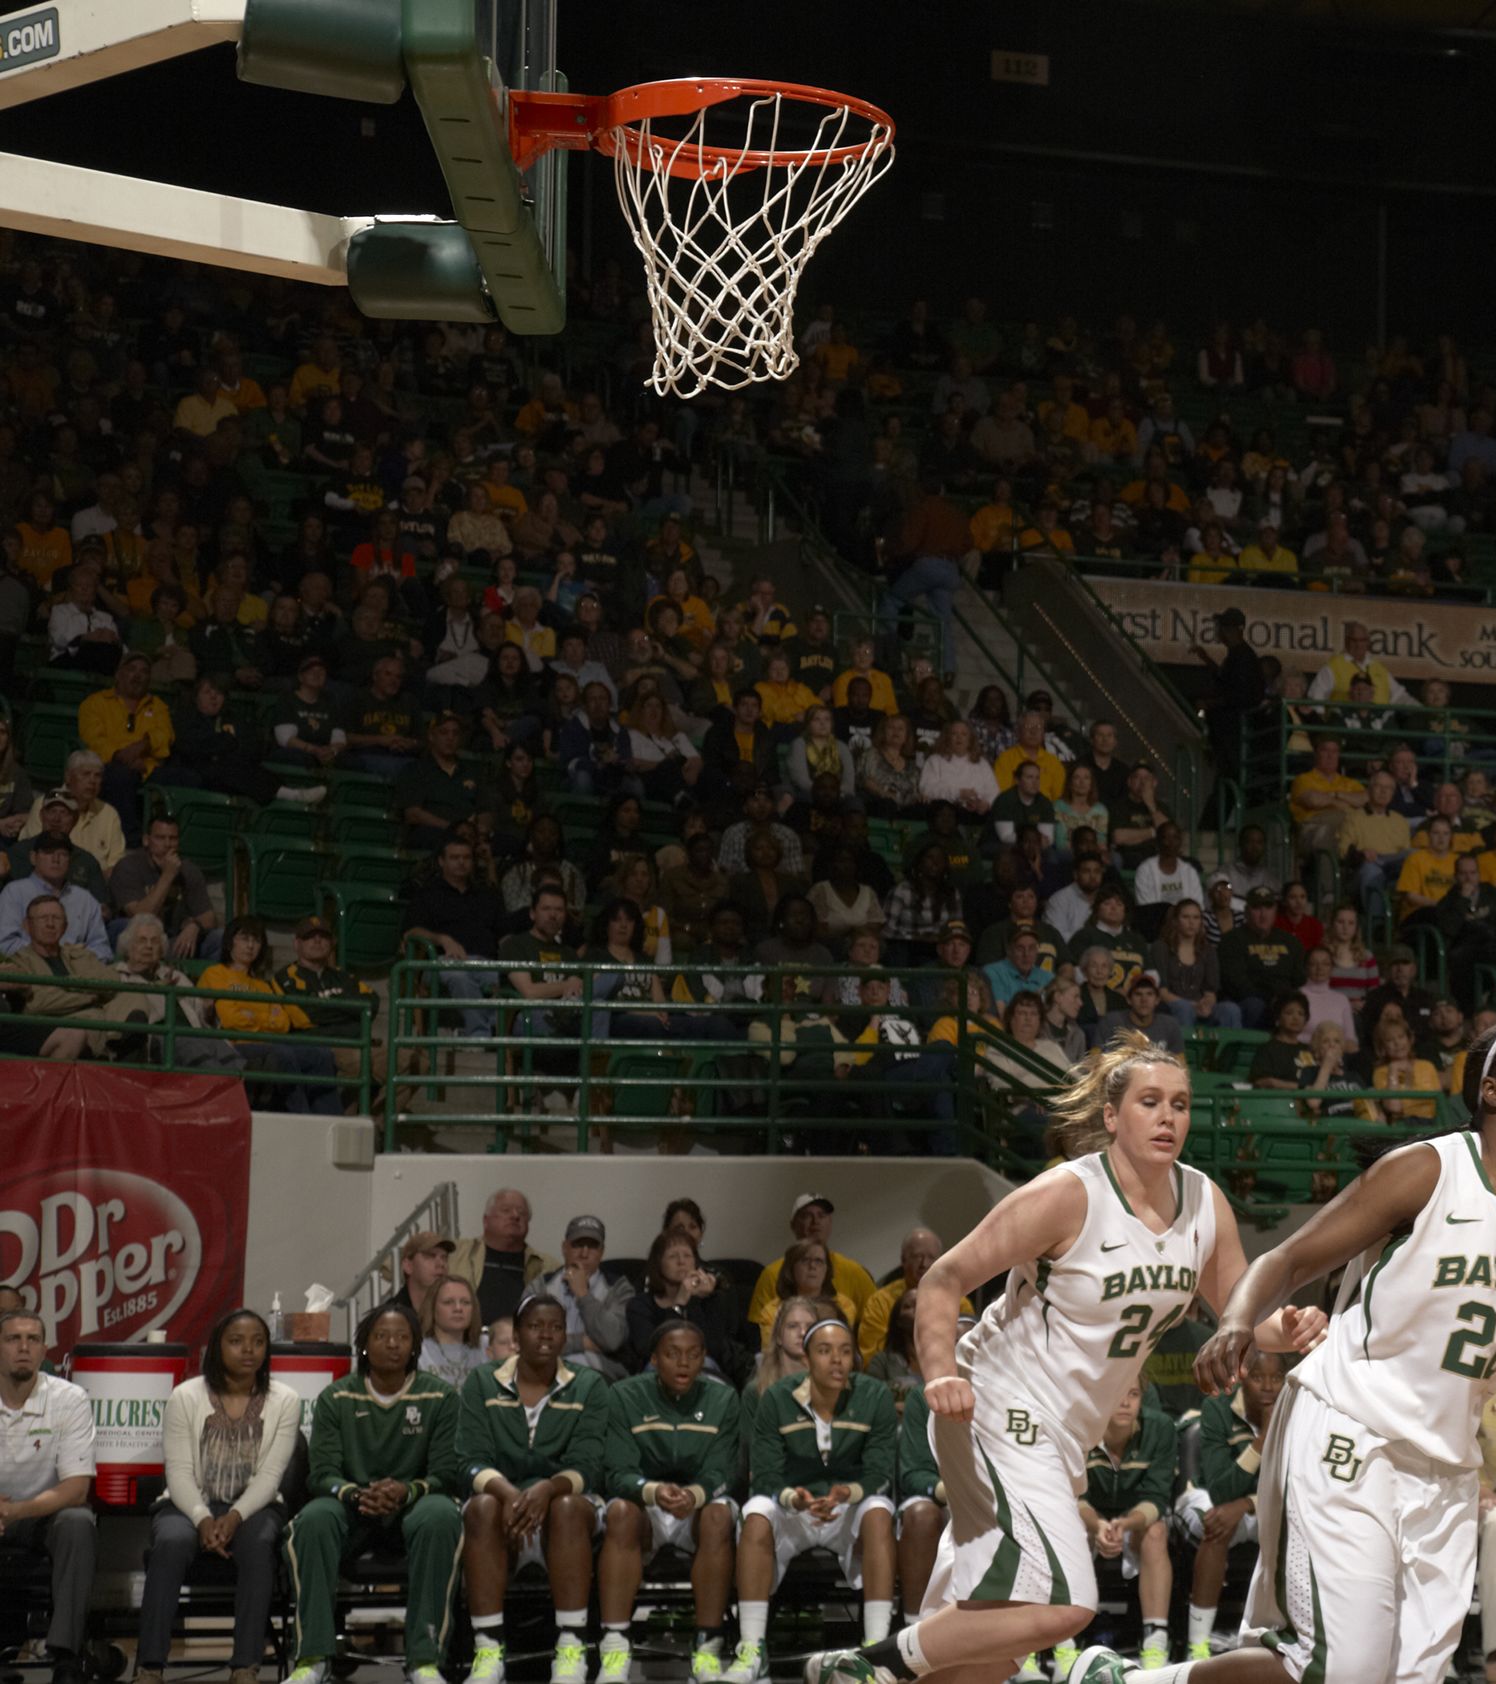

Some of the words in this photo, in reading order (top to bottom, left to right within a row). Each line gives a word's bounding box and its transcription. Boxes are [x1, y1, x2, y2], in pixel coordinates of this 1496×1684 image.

[0, 19, 53, 60] .COM
[1111, 606, 1161, 640] rst
[1171, 608, 1333, 652] Naonal
[39, 1191, 125, 1277] Dr
[1107, 1303, 1186, 1359] 24
[1006, 1408, 1039, 1446] BU
[1322, 1433, 1363, 1483] BU
